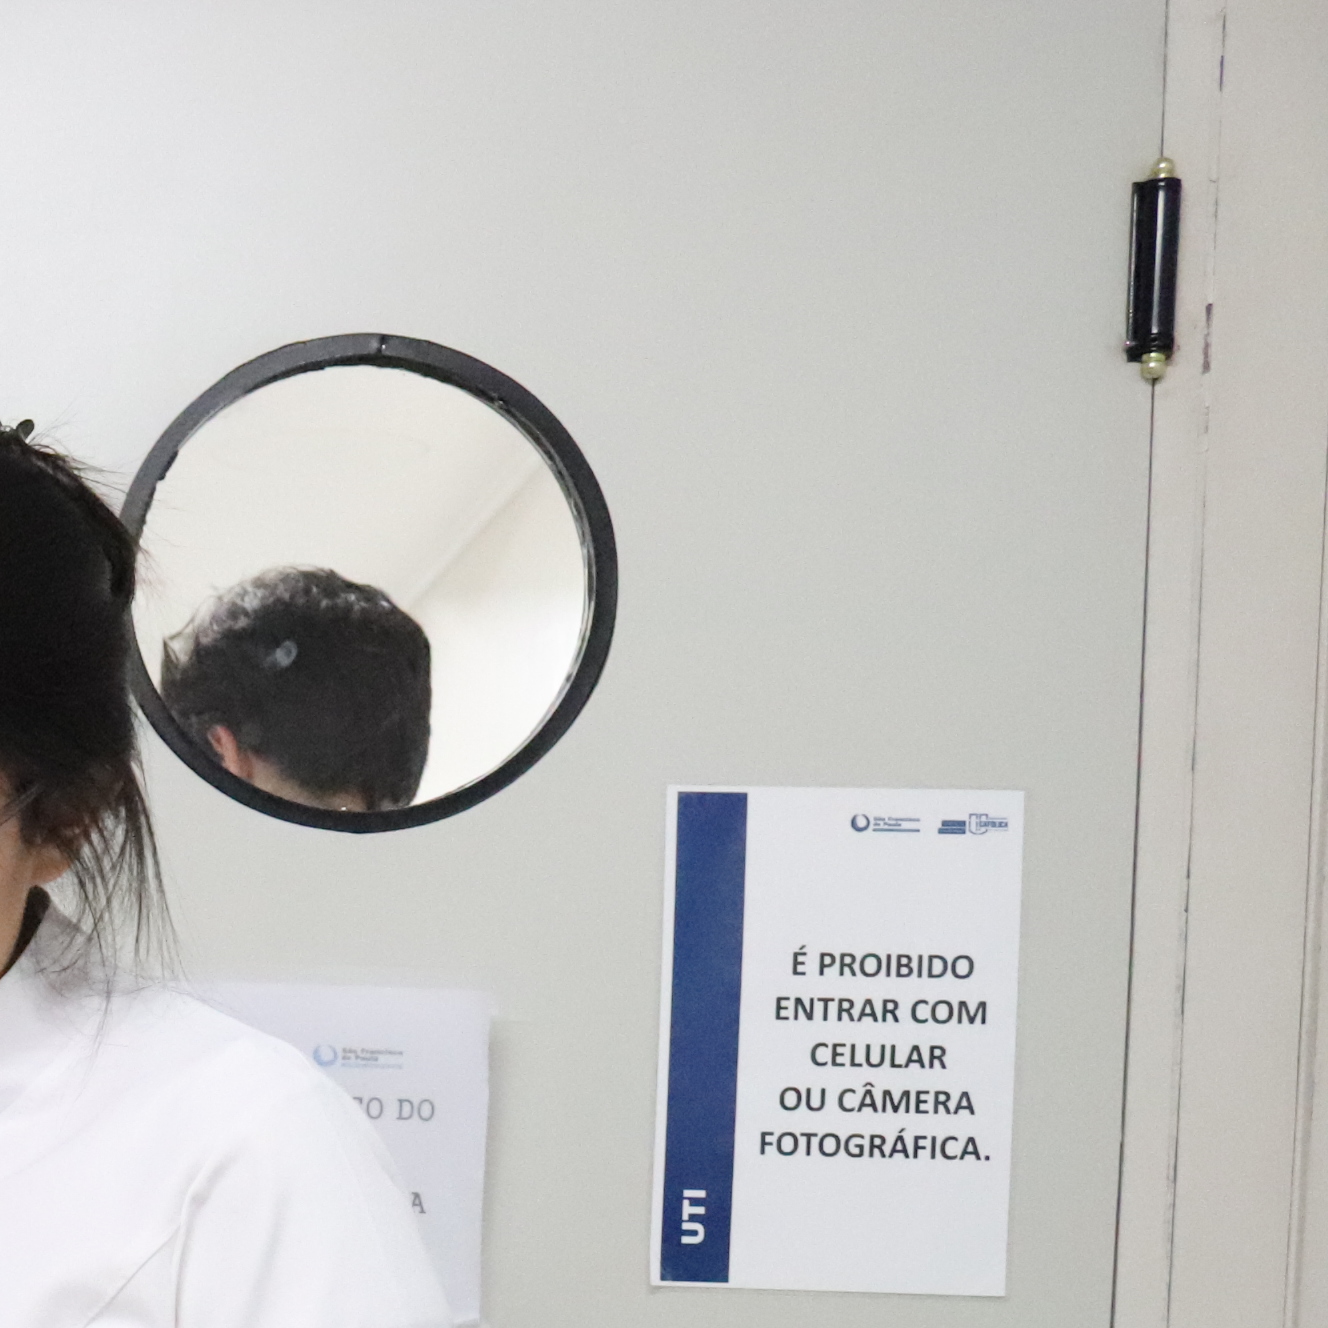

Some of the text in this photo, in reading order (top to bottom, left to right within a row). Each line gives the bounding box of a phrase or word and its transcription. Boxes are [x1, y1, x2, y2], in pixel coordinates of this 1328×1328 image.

[792, 945, 975, 980] É PROIBIDO
[775, 997, 987, 1025] ENTRAR COM
[810, 1043, 947, 1069] CELULAR
[396, 1099, 435, 1121] DO
[779, 1083, 975, 1115] OU CÂMERA
[759, 1129, 991, 1161] FOTOGRÁFICA.
[681, 1190, 706, 1244] UTI
